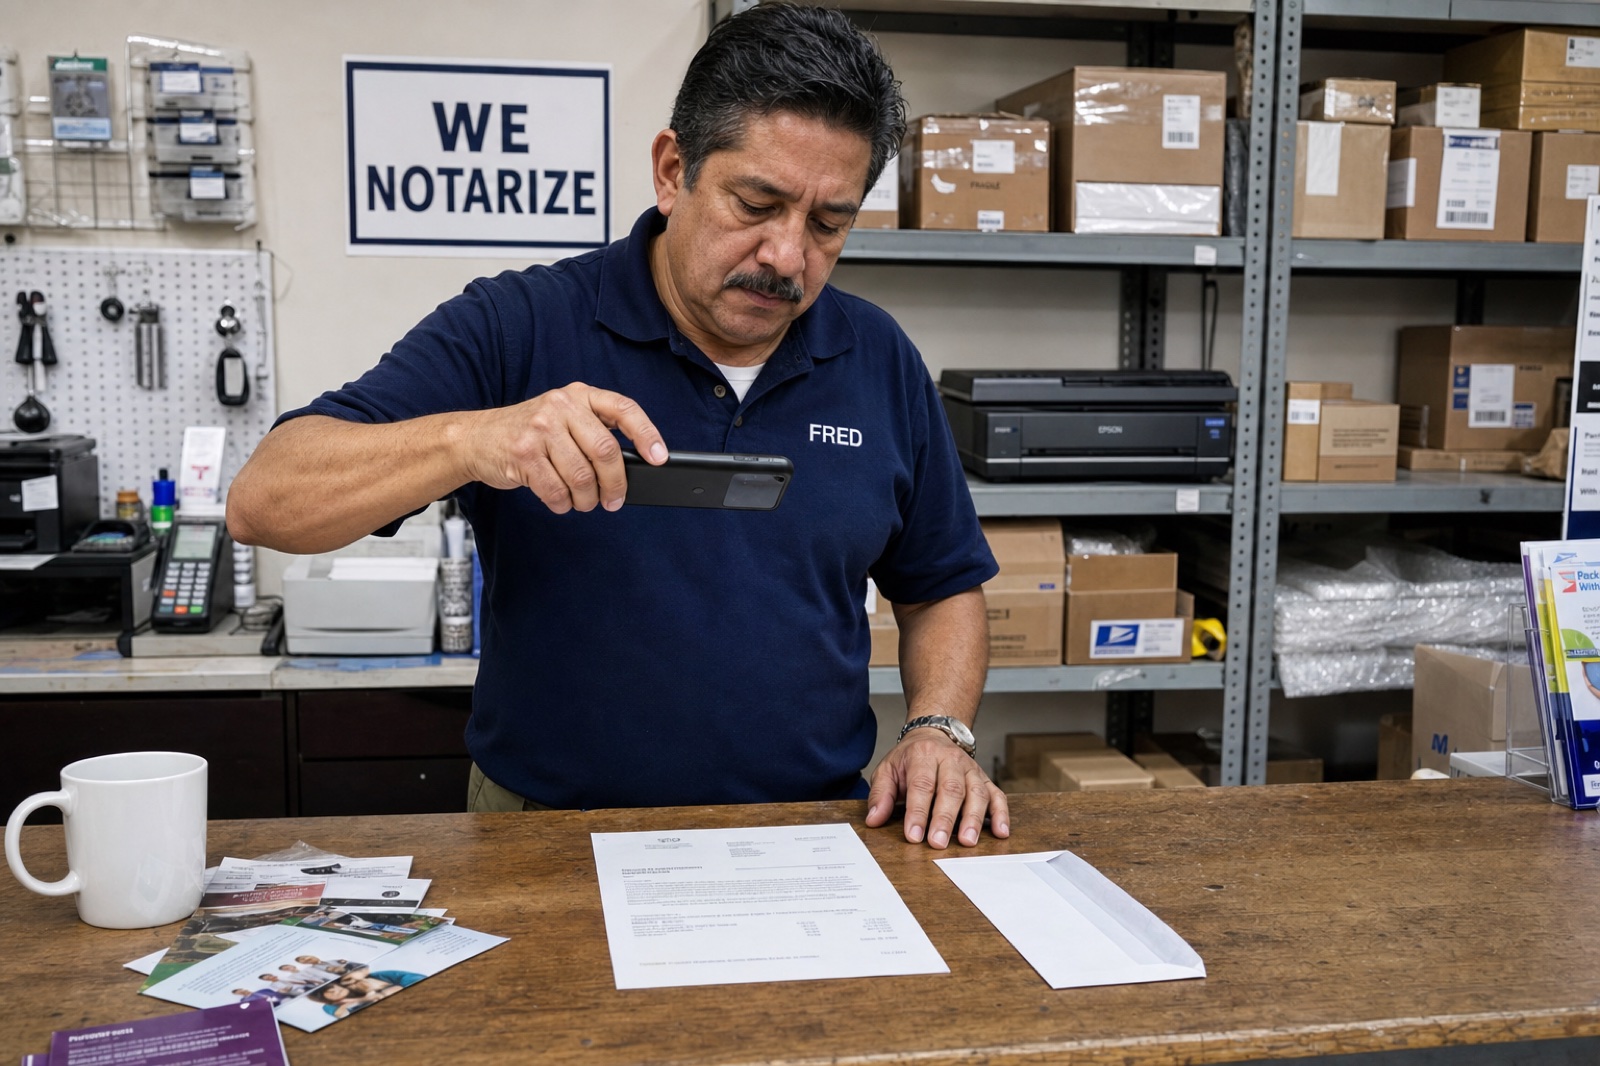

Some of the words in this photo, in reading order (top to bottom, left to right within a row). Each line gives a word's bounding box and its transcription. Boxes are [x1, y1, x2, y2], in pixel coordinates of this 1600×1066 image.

[432, 102, 529, 153] WE
[367, 165, 596, 215] NOTARIZE
[809, 423, 863, 447] FRED
[1098, 425, 1123, 434] EPSON
[1577, 570, 1600, 581] Pack
[1431, 733, 1448, 755] M
